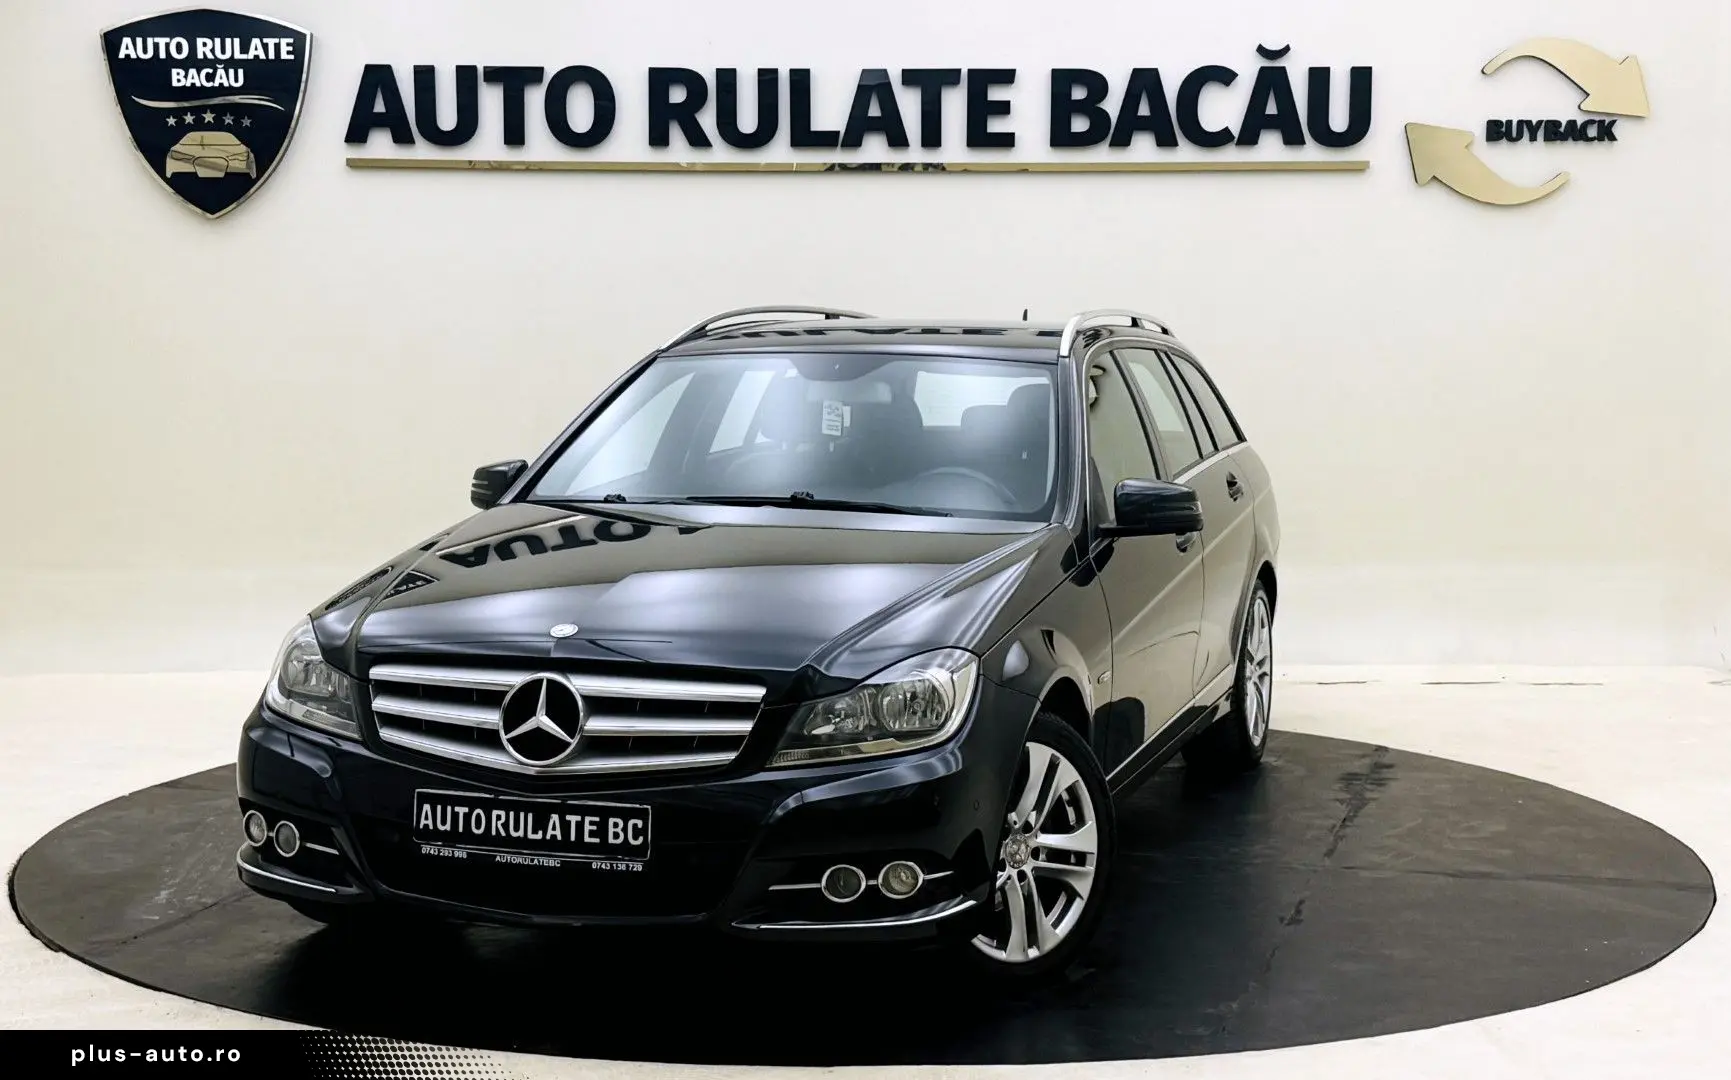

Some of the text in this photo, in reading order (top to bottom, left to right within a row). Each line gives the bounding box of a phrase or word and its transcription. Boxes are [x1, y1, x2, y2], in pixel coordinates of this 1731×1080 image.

[118, 37, 295, 60] AUTO RULATE
[171, 64, 245, 88] BACĂU
[344, 43, 1373, 151] AUTO RULATE BACĂU
[1485, 118, 1618, 143] BUYBACK
[419, 803, 645, 846] AUTO RULATE BC
[591, 861, 611, 870] 0743
